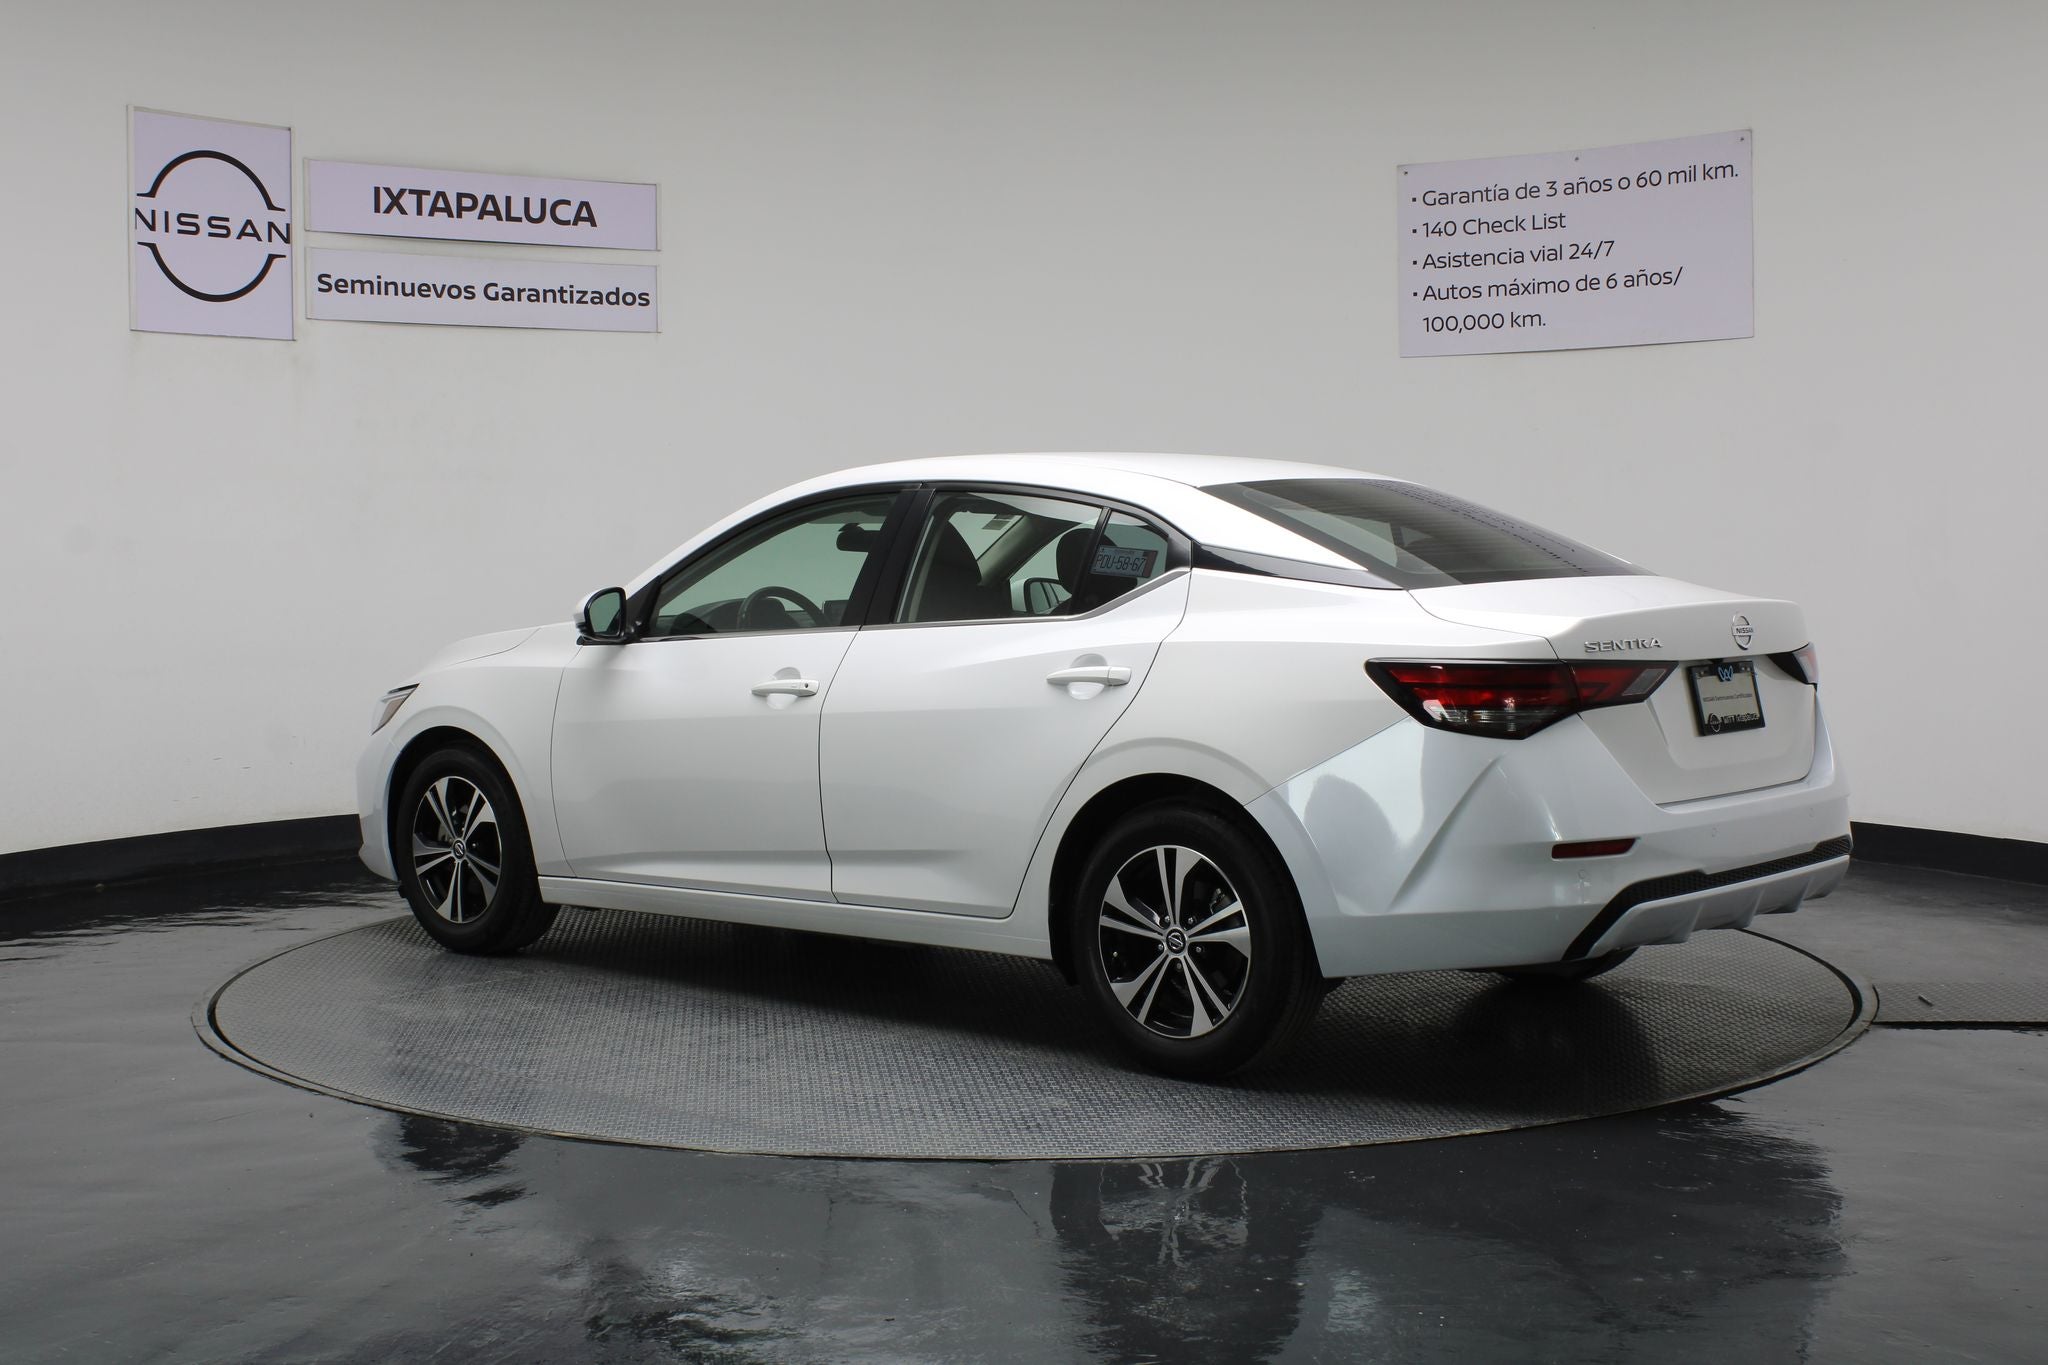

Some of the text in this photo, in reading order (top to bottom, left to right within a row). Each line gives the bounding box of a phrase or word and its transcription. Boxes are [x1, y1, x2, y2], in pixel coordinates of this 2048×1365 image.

[1422, 163, 1739, 207] Garantía de 3 años o 60 mil km.
[373, 186, 598, 228] IXTAPALUCA
[134, 207, 291, 245] NISSAN
[1422, 212, 1567, 238] 140 Check List
[1422, 240, 1615, 270] Asistencia vial 24/7
[317, 273, 651, 307] Seminuevos Garantizados
[1422, 266, 1684, 302] Autos máximo de 6 años/
[1422, 311, 1546, 334] 100,000 km.
[1584, 637, 1663, 653] SENTRA
